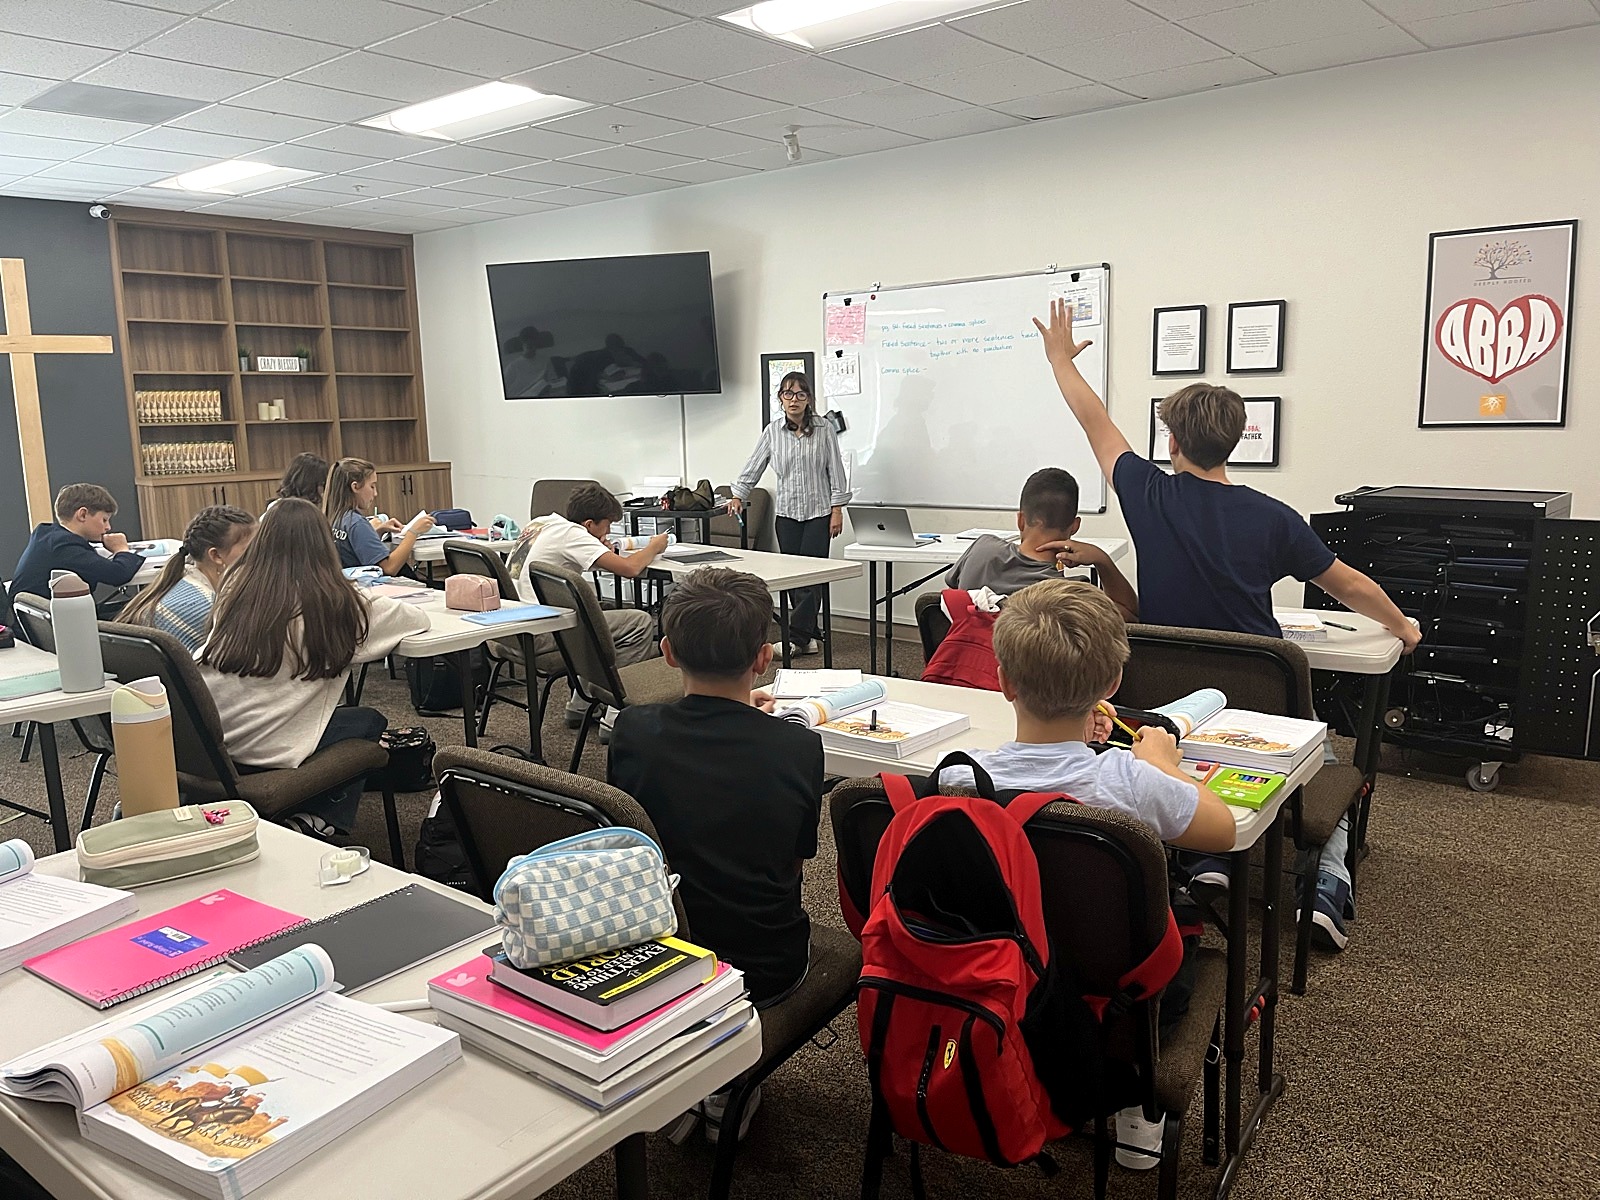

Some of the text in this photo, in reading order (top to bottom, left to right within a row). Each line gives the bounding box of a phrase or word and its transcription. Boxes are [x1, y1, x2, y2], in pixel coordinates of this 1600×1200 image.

[1440, 298, 1556, 379] ABBA
[260, 357, 298, 370] CRAZY BLESSED
[1241, 432, 1263, 440] FATHER
[632, 943, 657, 956] YOU
[552, 946, 628, 981] ORLD
[603, 952, 635, 969] NEED
[573, 944, 668, 991] EVERYTHING
[587, 967, 606, 976] TO
[563, 974, 587, 986] ACE
